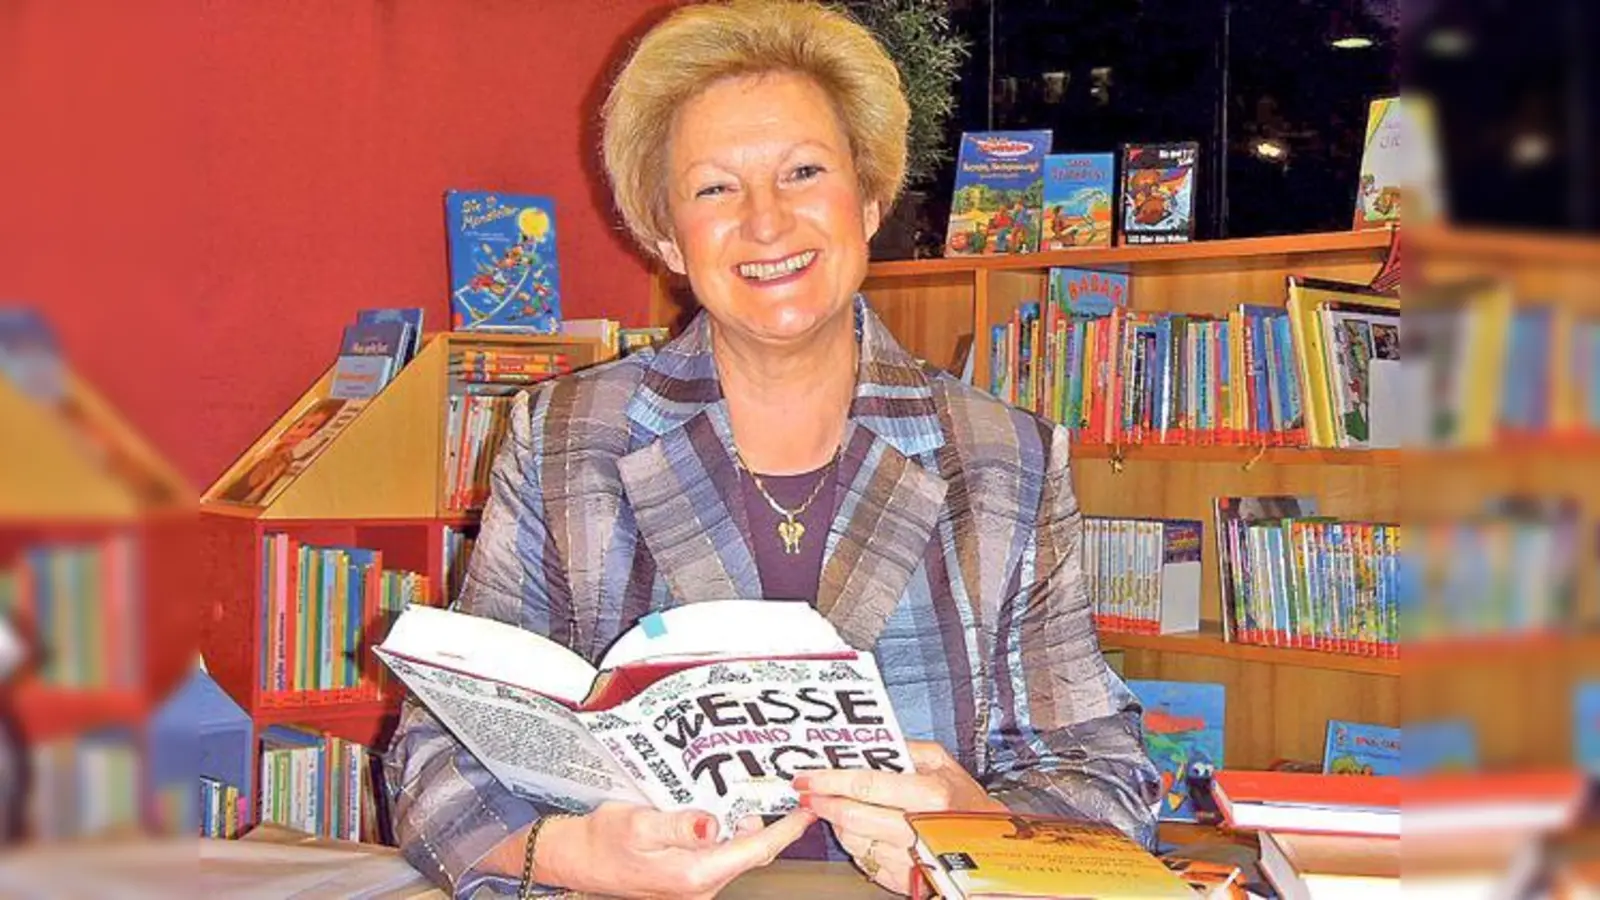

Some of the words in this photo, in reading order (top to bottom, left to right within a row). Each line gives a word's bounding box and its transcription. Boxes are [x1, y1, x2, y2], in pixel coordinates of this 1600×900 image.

[653, 699, 694, 732] DER
[664, 688, 884, 750] WEISSE
[681, 727, 792, 772] ARAVIND
[690, 745, 905, 797] TIGER
